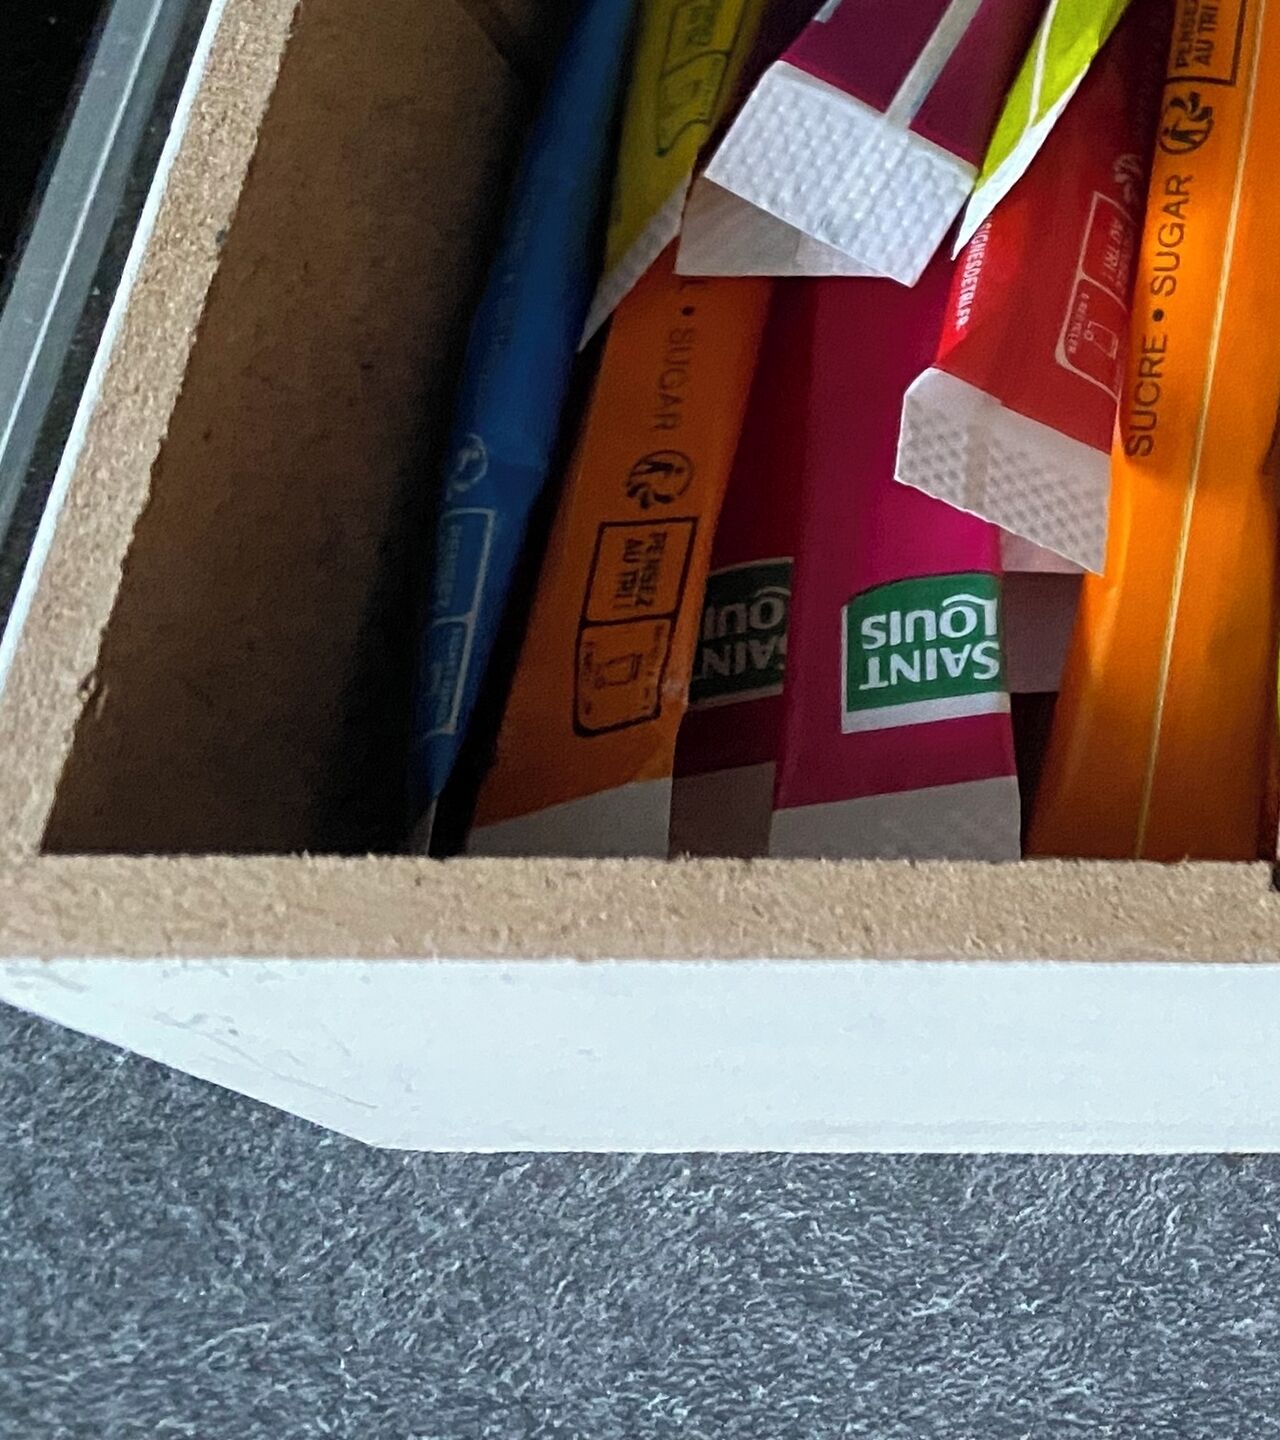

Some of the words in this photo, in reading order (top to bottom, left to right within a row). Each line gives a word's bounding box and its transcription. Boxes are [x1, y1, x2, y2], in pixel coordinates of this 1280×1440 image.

[1195, 38, 1215, 67] AU
[1125, 334, 1168, 458] SUCRE
[1151, 173, 1194, 298] SUGAR
[653, 327, 695, 431] SUGAR
[860, 593, 998, 650] LOUIS
[859, 640, 1001, 690] SAINT
